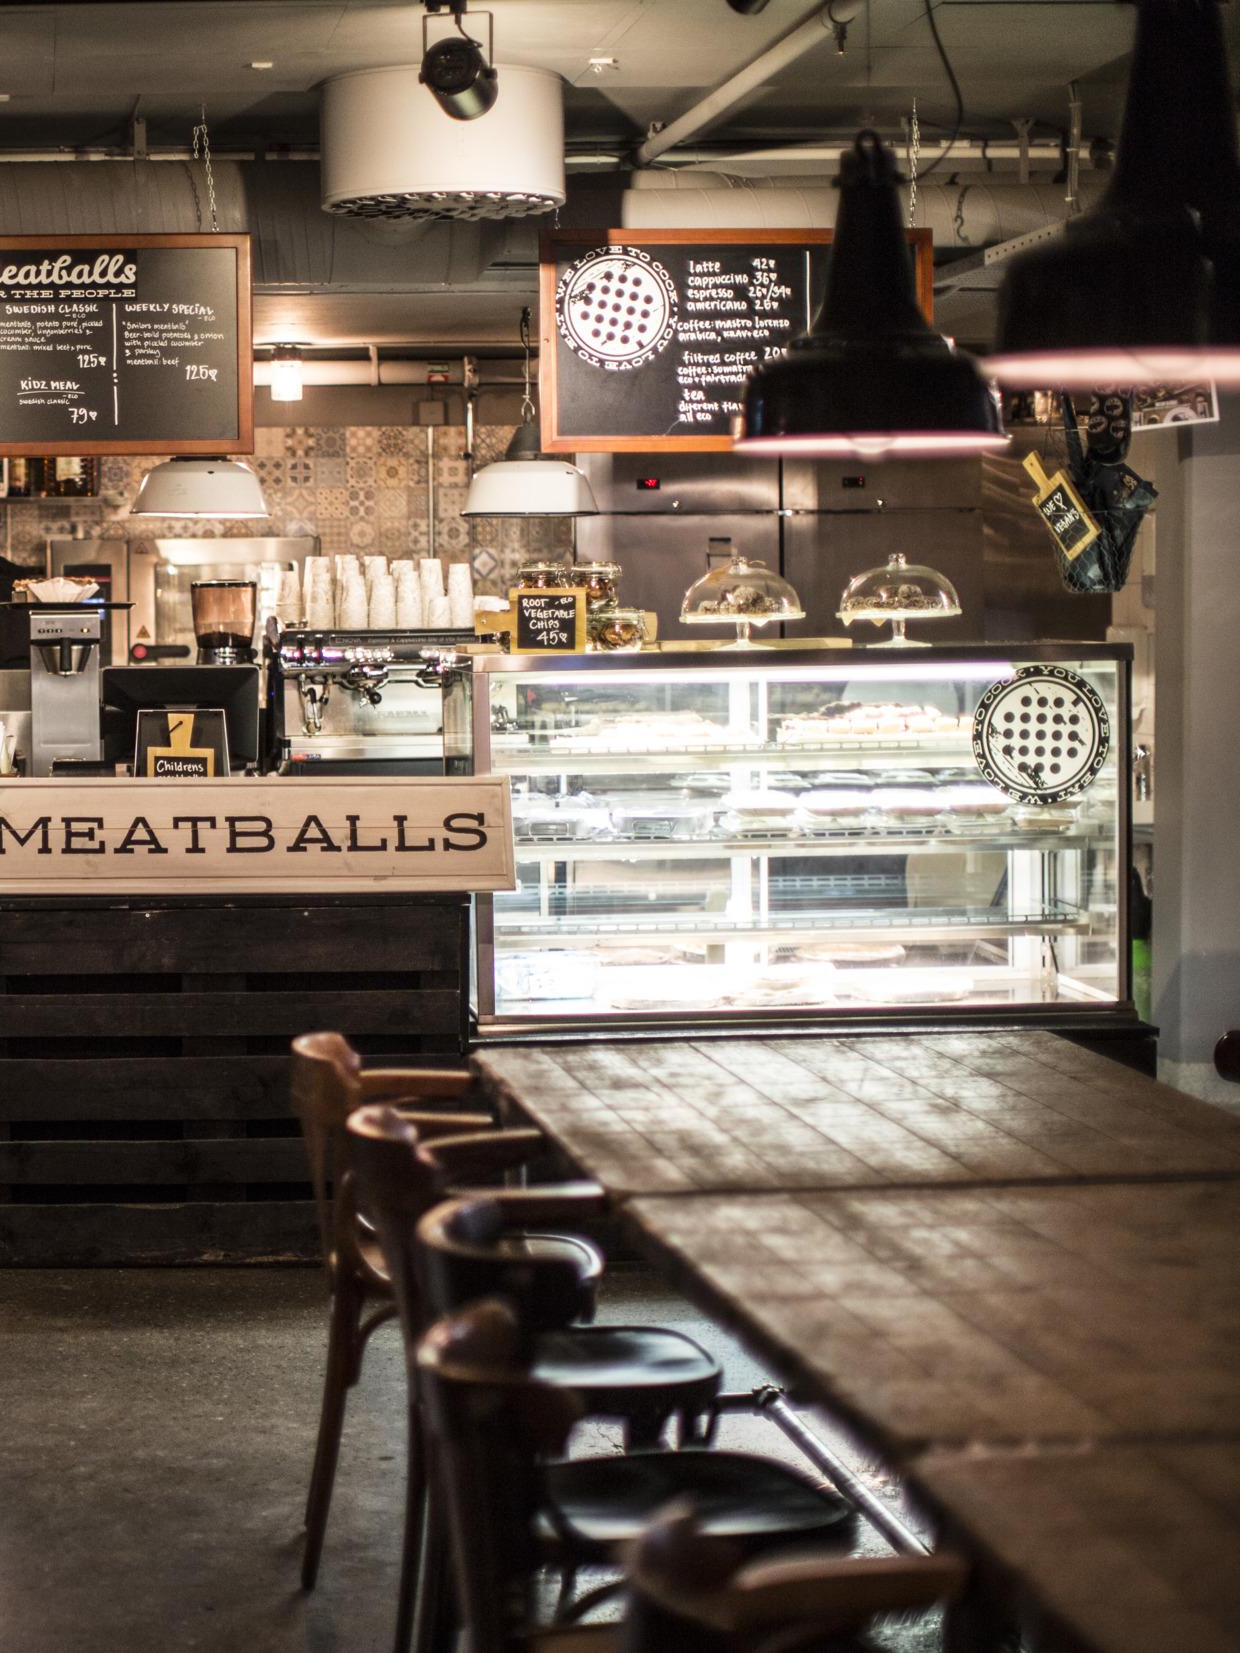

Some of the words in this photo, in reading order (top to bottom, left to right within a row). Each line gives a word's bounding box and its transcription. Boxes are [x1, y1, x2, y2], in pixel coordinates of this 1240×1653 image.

[689, 260, 720, 273] latte
[752, 258, 769, 269] 42
[556, 269, 575, 299] WE
[574, 246, 622, 268] LOVE
[627, 247, 650, 262] TO
[652, 262, 678, 304] COOK
[688, 273, 749, 288] cappuccino
[11, 290, 53, 298] THE
[59, 289, 136, 298] PEOPLE
[687, 288, 734, 300] espresso
[125, 303, 170, 312] WEEKLY
[687, 300, 748, 311] americano
[36, 321, 60, 329] potato
[556, 312, 578, 350] EAT
[657, 315, 678, 352] YOU
[77, 353, 98, 368] 125
[162, 357, 180, 367] beef
[578, 350, 601, 367] TO
[604, 351, 655, 370] LOVE
[724, 351, 758, 364] coffee
[763, 346, 781, 359] 20
[50, 380, 80, 390] MEAL
[683, 388, 705, 401] tea
[68, 408, 88, 424] 79
[679, 412, 694, 421] all
[696, 412, 712, 420] eco
[522, 598, 550, 607] ROOT
[523, 609, 575, 619] VEGETABLE
[529, 619, 560, 630] CHIPS
[536, 630, 560, 646] 45
[1040, 665, 1081, 683] YOU
[1082, 684, 1109, 737] LOVE
[974, 708, 985, 735] TO
[1094, 744, 1108, 769] TO
[156, 760, 204, 773] Childrens
[973, 741, 1006, 792] LOVE
[1057, 771, 1095, 801] EAT
[1008, 790, 1043, 805] WE
